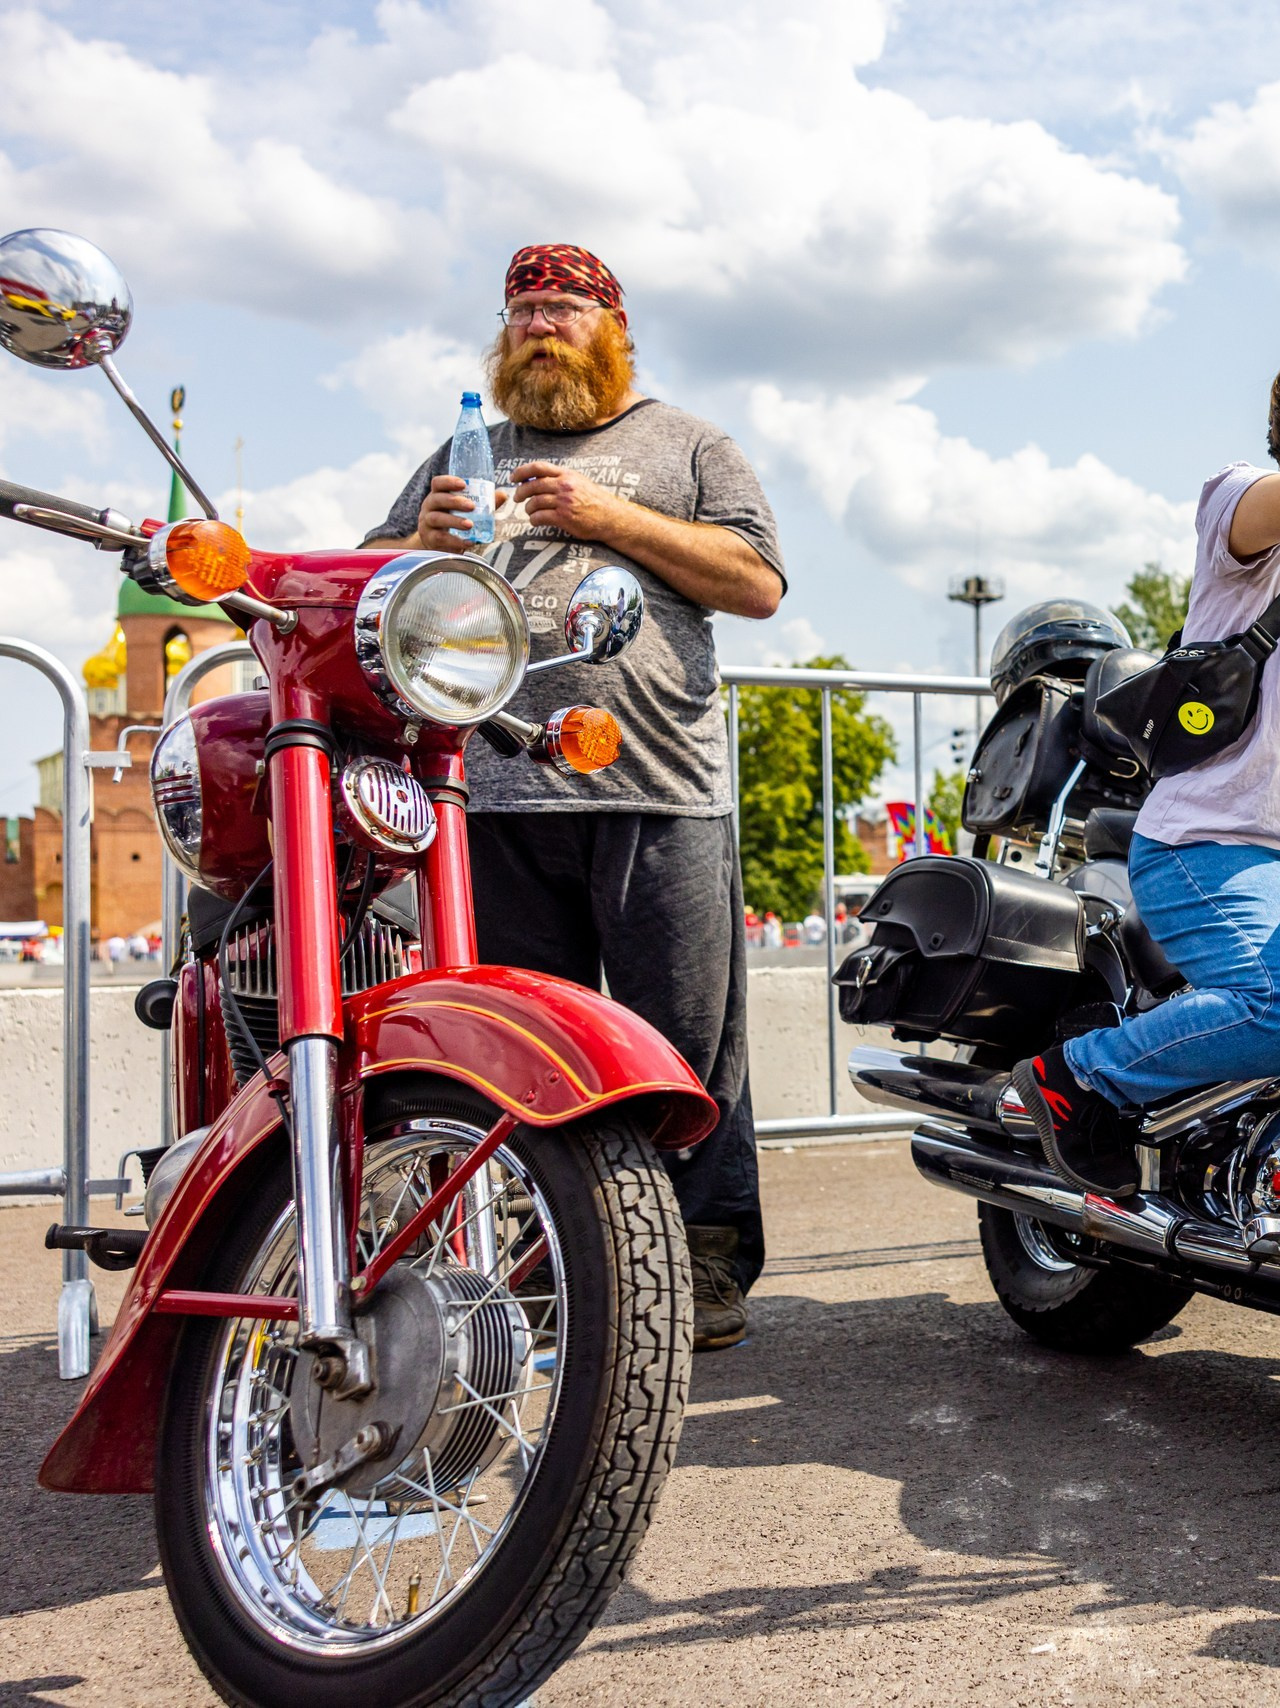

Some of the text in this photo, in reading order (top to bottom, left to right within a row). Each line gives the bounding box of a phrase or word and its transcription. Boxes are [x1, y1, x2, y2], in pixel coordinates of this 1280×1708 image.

[559, 455, 622, 469] CONNECTION
[531, 595, 558, 609] GO
[1142, 719, 1155, 740] WARP
